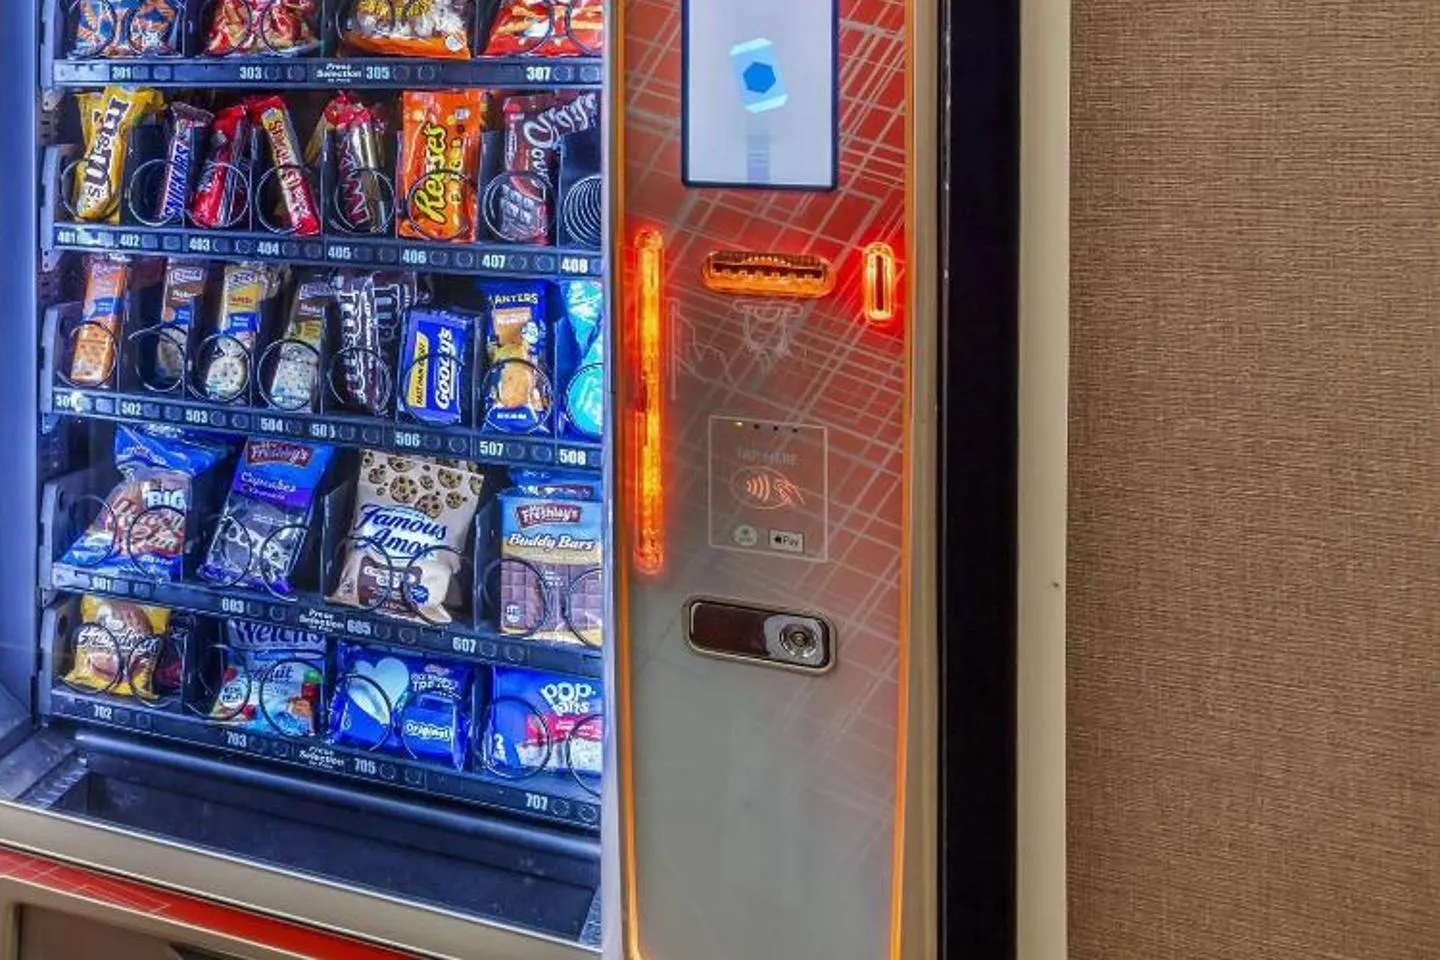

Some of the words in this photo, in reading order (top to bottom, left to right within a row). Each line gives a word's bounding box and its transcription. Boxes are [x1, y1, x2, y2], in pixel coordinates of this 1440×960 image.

[112, 66, 132, 79] 301
[239, 66, 262, 80] 303
[366, 66, 390, 80] 305
[526, 66, 551, 81] 307
[119, 233, 140, 248] 402
[189, 236, 210, 250] 403
[257, 241, 280, 255] 404
[328, 246, 352, 260] 405
[402, 248, 427, 264] 406
[481, 254, 506, 269] 407
[561, 258, 588, 273] 408
[122, 401, 142, 416] 502
[185, 409, 208, 424] 503
[261, 417, 283, 432] 504
[396, 432, 421, 447] 506
[480, 442, 504, 457] 507
[560, 449, 586, 465] 508
[148, 491, 186, 508] BIG
[353, 502, 447, 540] Famous
[508, 533, 556, 549] Buddy
[558, 534, 595, 550] Bars
[222, 598, 244, 613] 603
[452, 639, 476, 653] 607
[227, 732, 247, 748] 703
[354, 757, 377, 775] 705
[525, 792, 548, 810] 707
